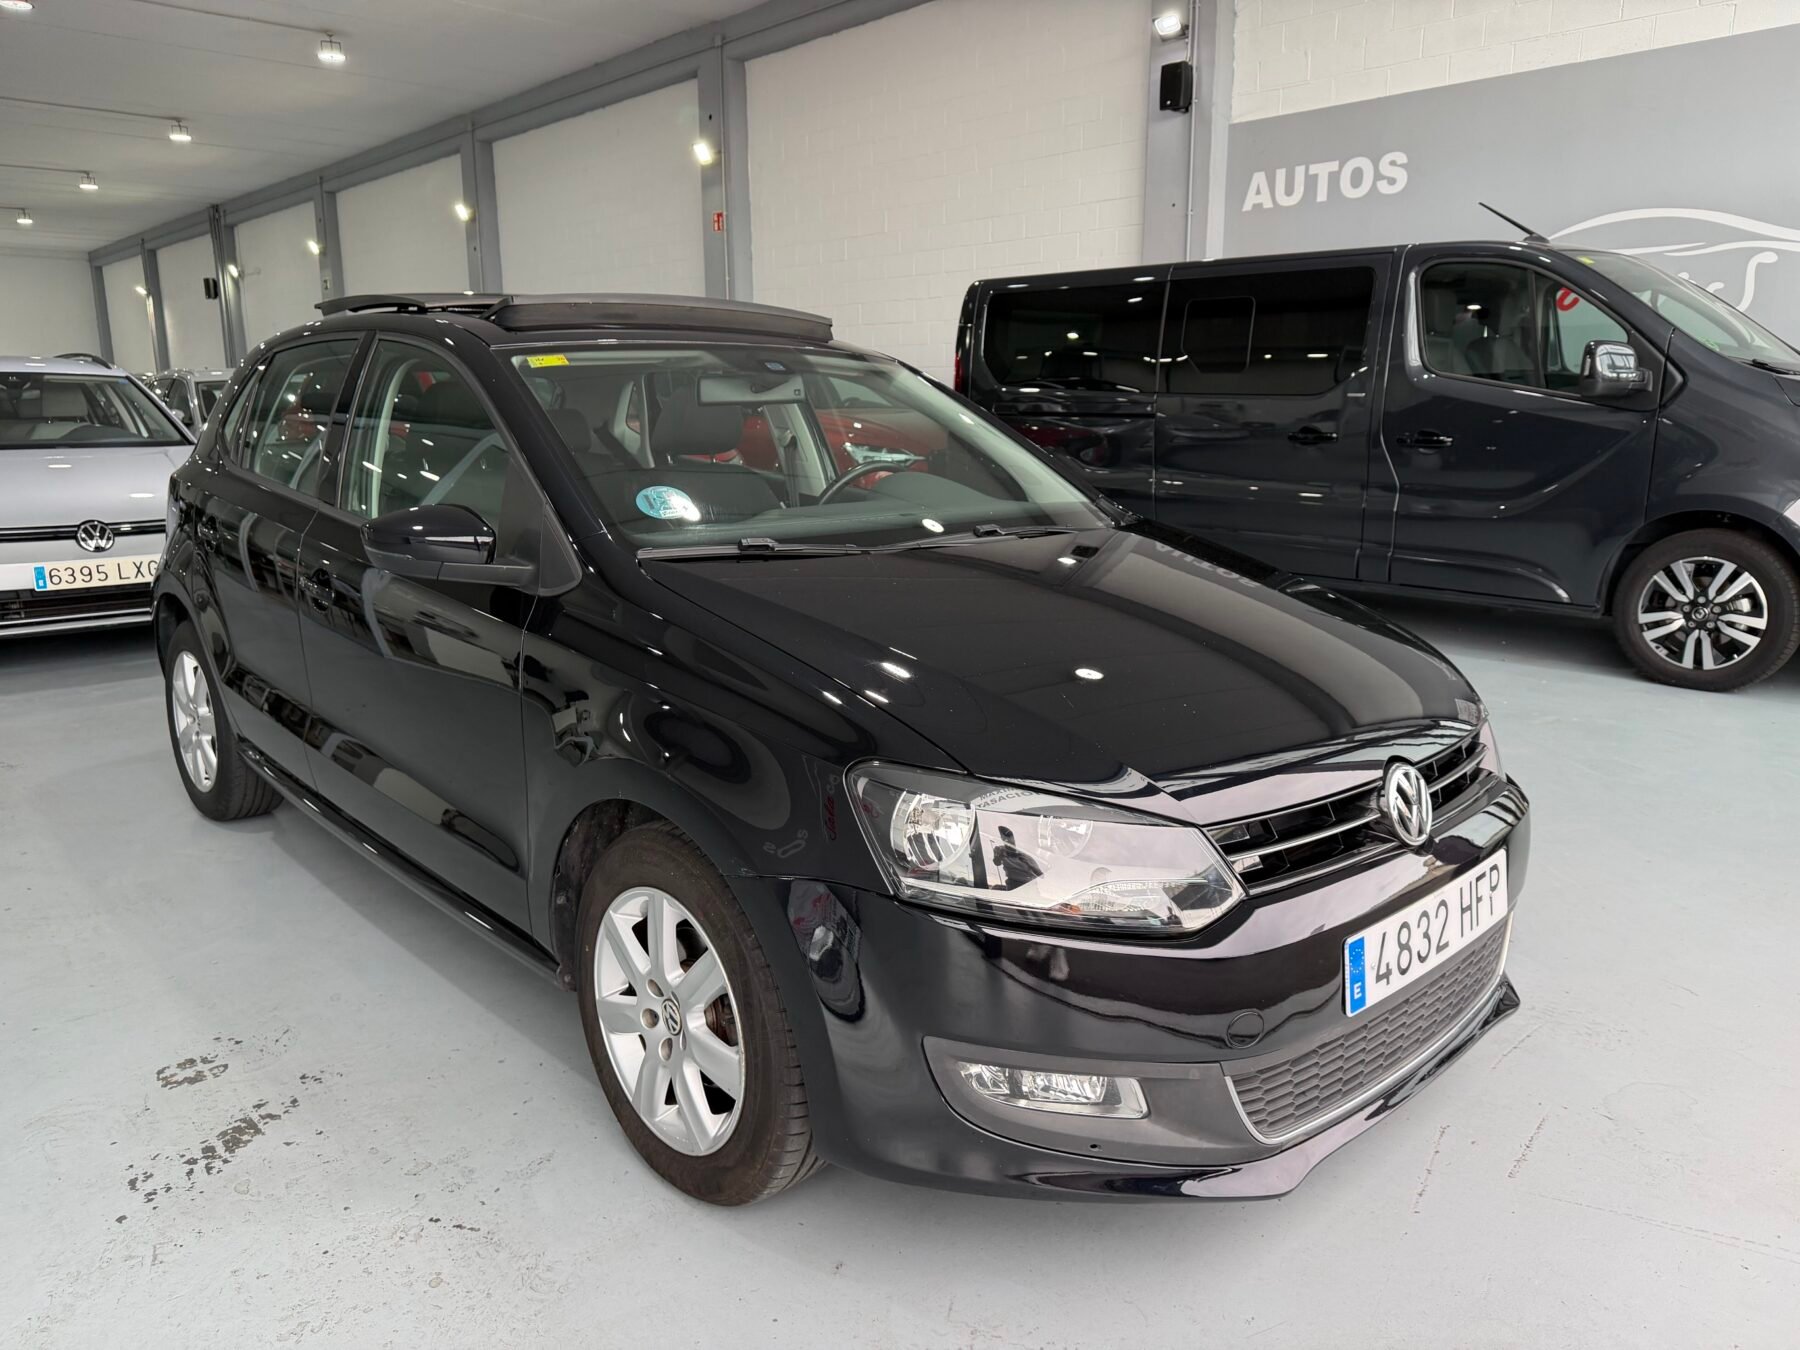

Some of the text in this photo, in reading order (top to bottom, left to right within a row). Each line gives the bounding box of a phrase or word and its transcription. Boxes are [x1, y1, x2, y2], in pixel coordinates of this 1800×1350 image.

[1242, 151, 1409, 212] AUTOS
[48, 563, 109, 585] 6395
[1375, 863, 1500, 986] 4832 HFP
[1353, 981, 1362, 1000] E
